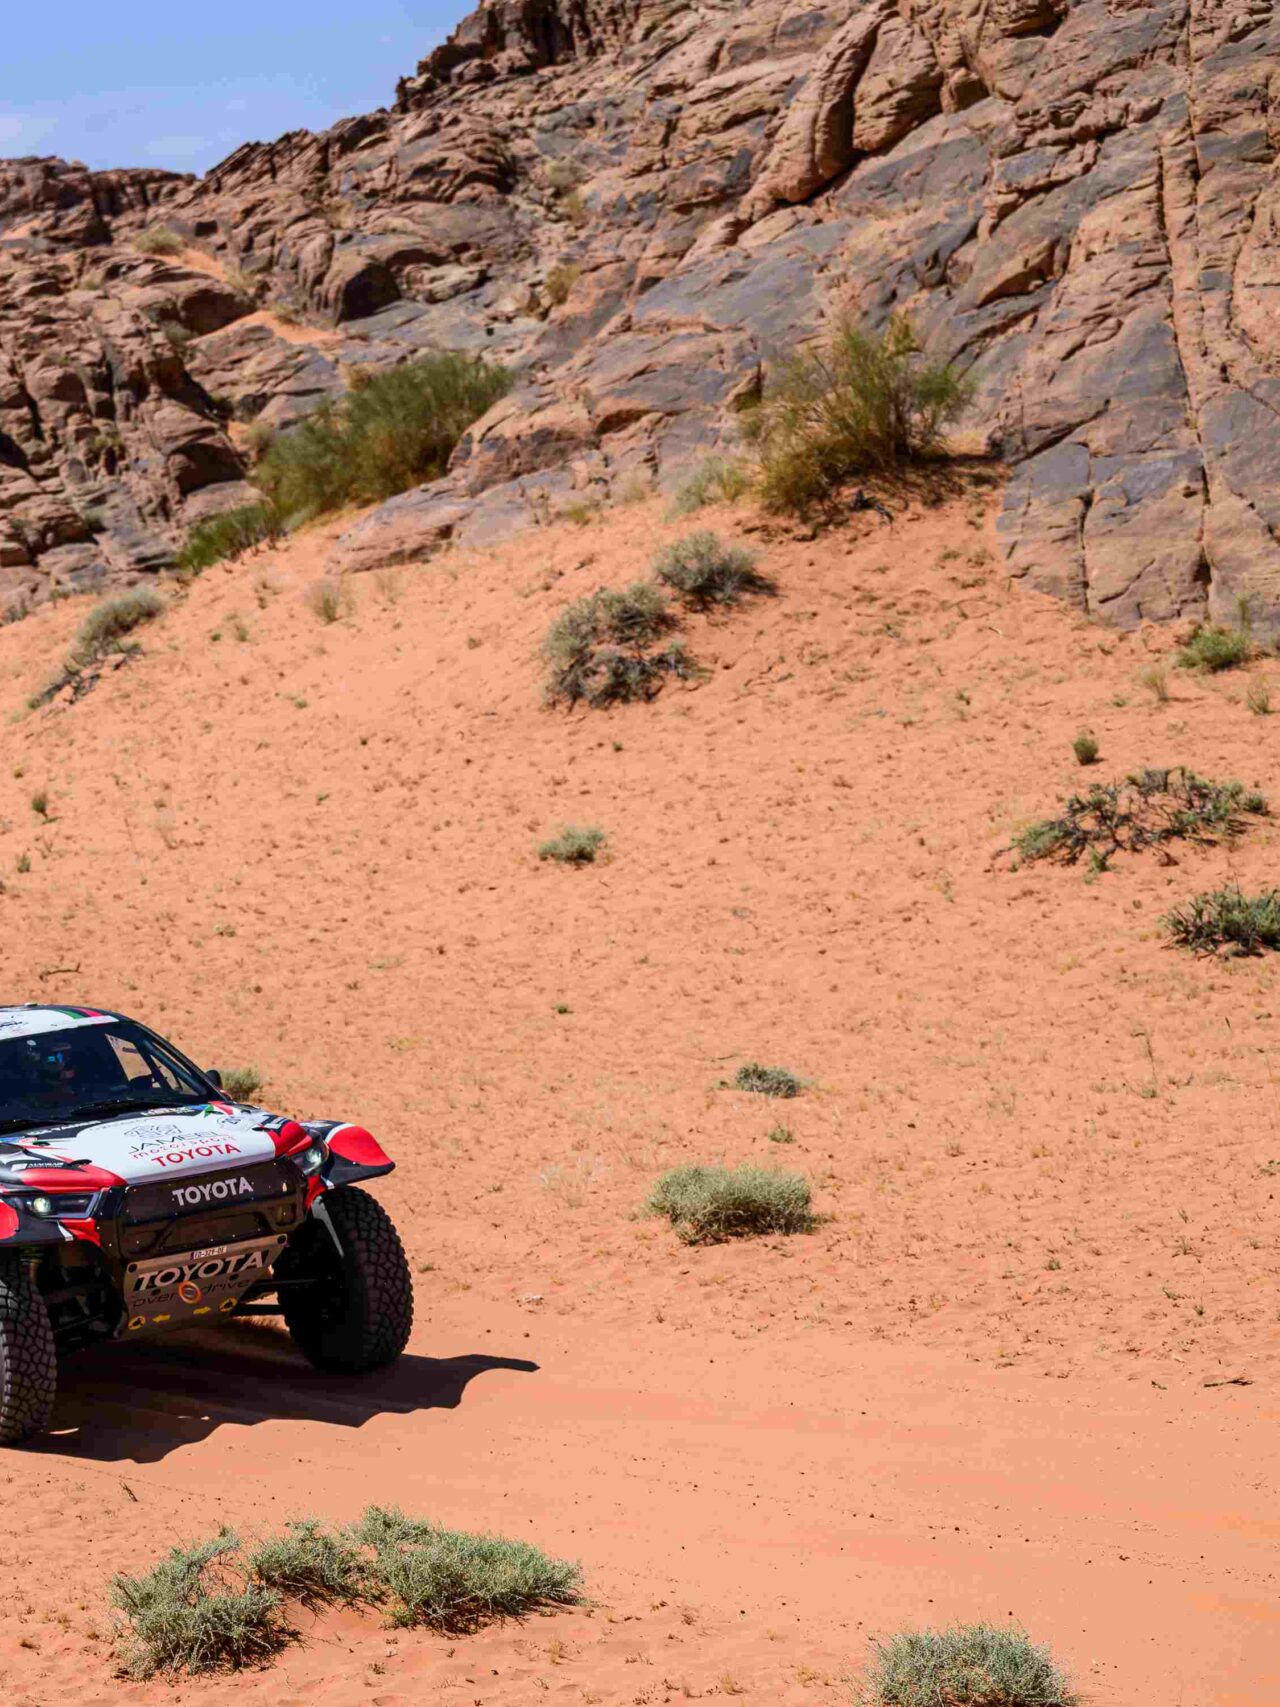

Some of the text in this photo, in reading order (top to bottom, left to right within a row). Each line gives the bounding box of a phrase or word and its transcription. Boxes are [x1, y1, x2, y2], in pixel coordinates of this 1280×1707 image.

[151, 1144, 242, 1167] TOYOTA
[172, 1177, 254, 1206] TOYOTA
[133, 1250, 267, 1291] TOYOTA
[132, 1278, 251, 1309] over drive
